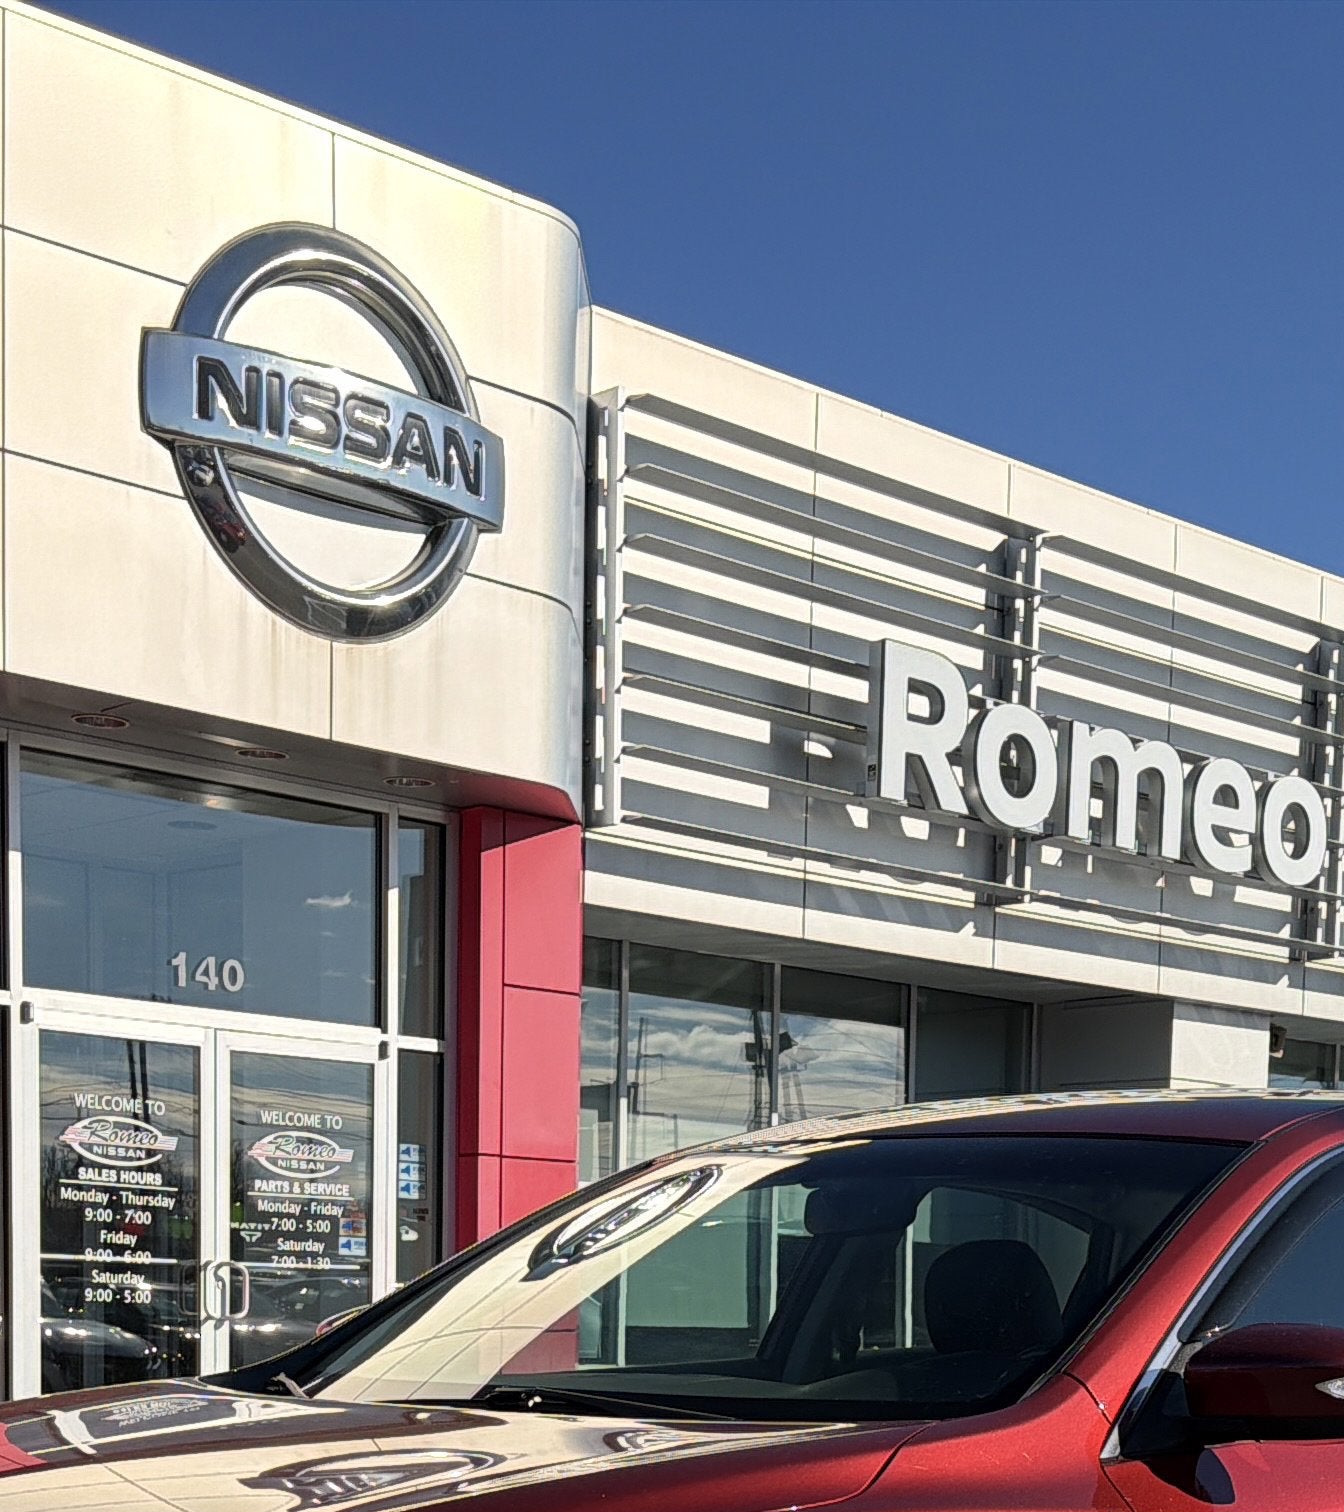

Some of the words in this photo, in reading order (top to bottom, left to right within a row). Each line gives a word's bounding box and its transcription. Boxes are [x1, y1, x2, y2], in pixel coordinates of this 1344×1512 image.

[193, 355, 486, 501] NISSAN
[869, 638, 1327, 887] Romeo
[171, 951, 245, 992] 140
[74, 1093, 143, 1113] WELCOME
[145, 1100, 166, 1116] TO
[260, 1110, 322, 1128] WELCOME
[325, 1115, 343, 1130] TO
[82, 1119, 159, 1146] Romeo
[93, 1145, 146, 1159] NISSAN
[268, 1135, 337, 1159] Romeo
[277, 1159, 325, 1171] NISSAN
[78, 1167, 118, 1181] SALES
[120, 1170, 162, 1185] HOURS
[254, 1179, 290, 1193] PARTS
[292, 1182, 301, 1194] &
[304, 1183, 350, 1196] SERVICE
[60, 1187, 110, 1205] Monday
[119, 1191, 176, 1210] Thursday
[84, 1208, 113, 1222] 9:00
[124, 1209, 152, 1225] 7:00
[257, 1199, 302, 1217] Monday
[310, 1202, 344, 1218] Friday
[271, 1218, 296, 1232] 7:00
[306, 1219, 331, 1233] 5:00
[100, 1230, 137, 1247] Friday
[277, 1237, 325, 1254] Saturday
[84, 1248, 113, 1263] 9:00
[123, 1250, 151, 1264] 6:00
[271, 1255, 296, 1269] 7:00
[91, 1269, 145, 1286] Saturday
[84, 1288, 113, 1302] 9:00
[123, 1290, 151, 1304] 5:00
